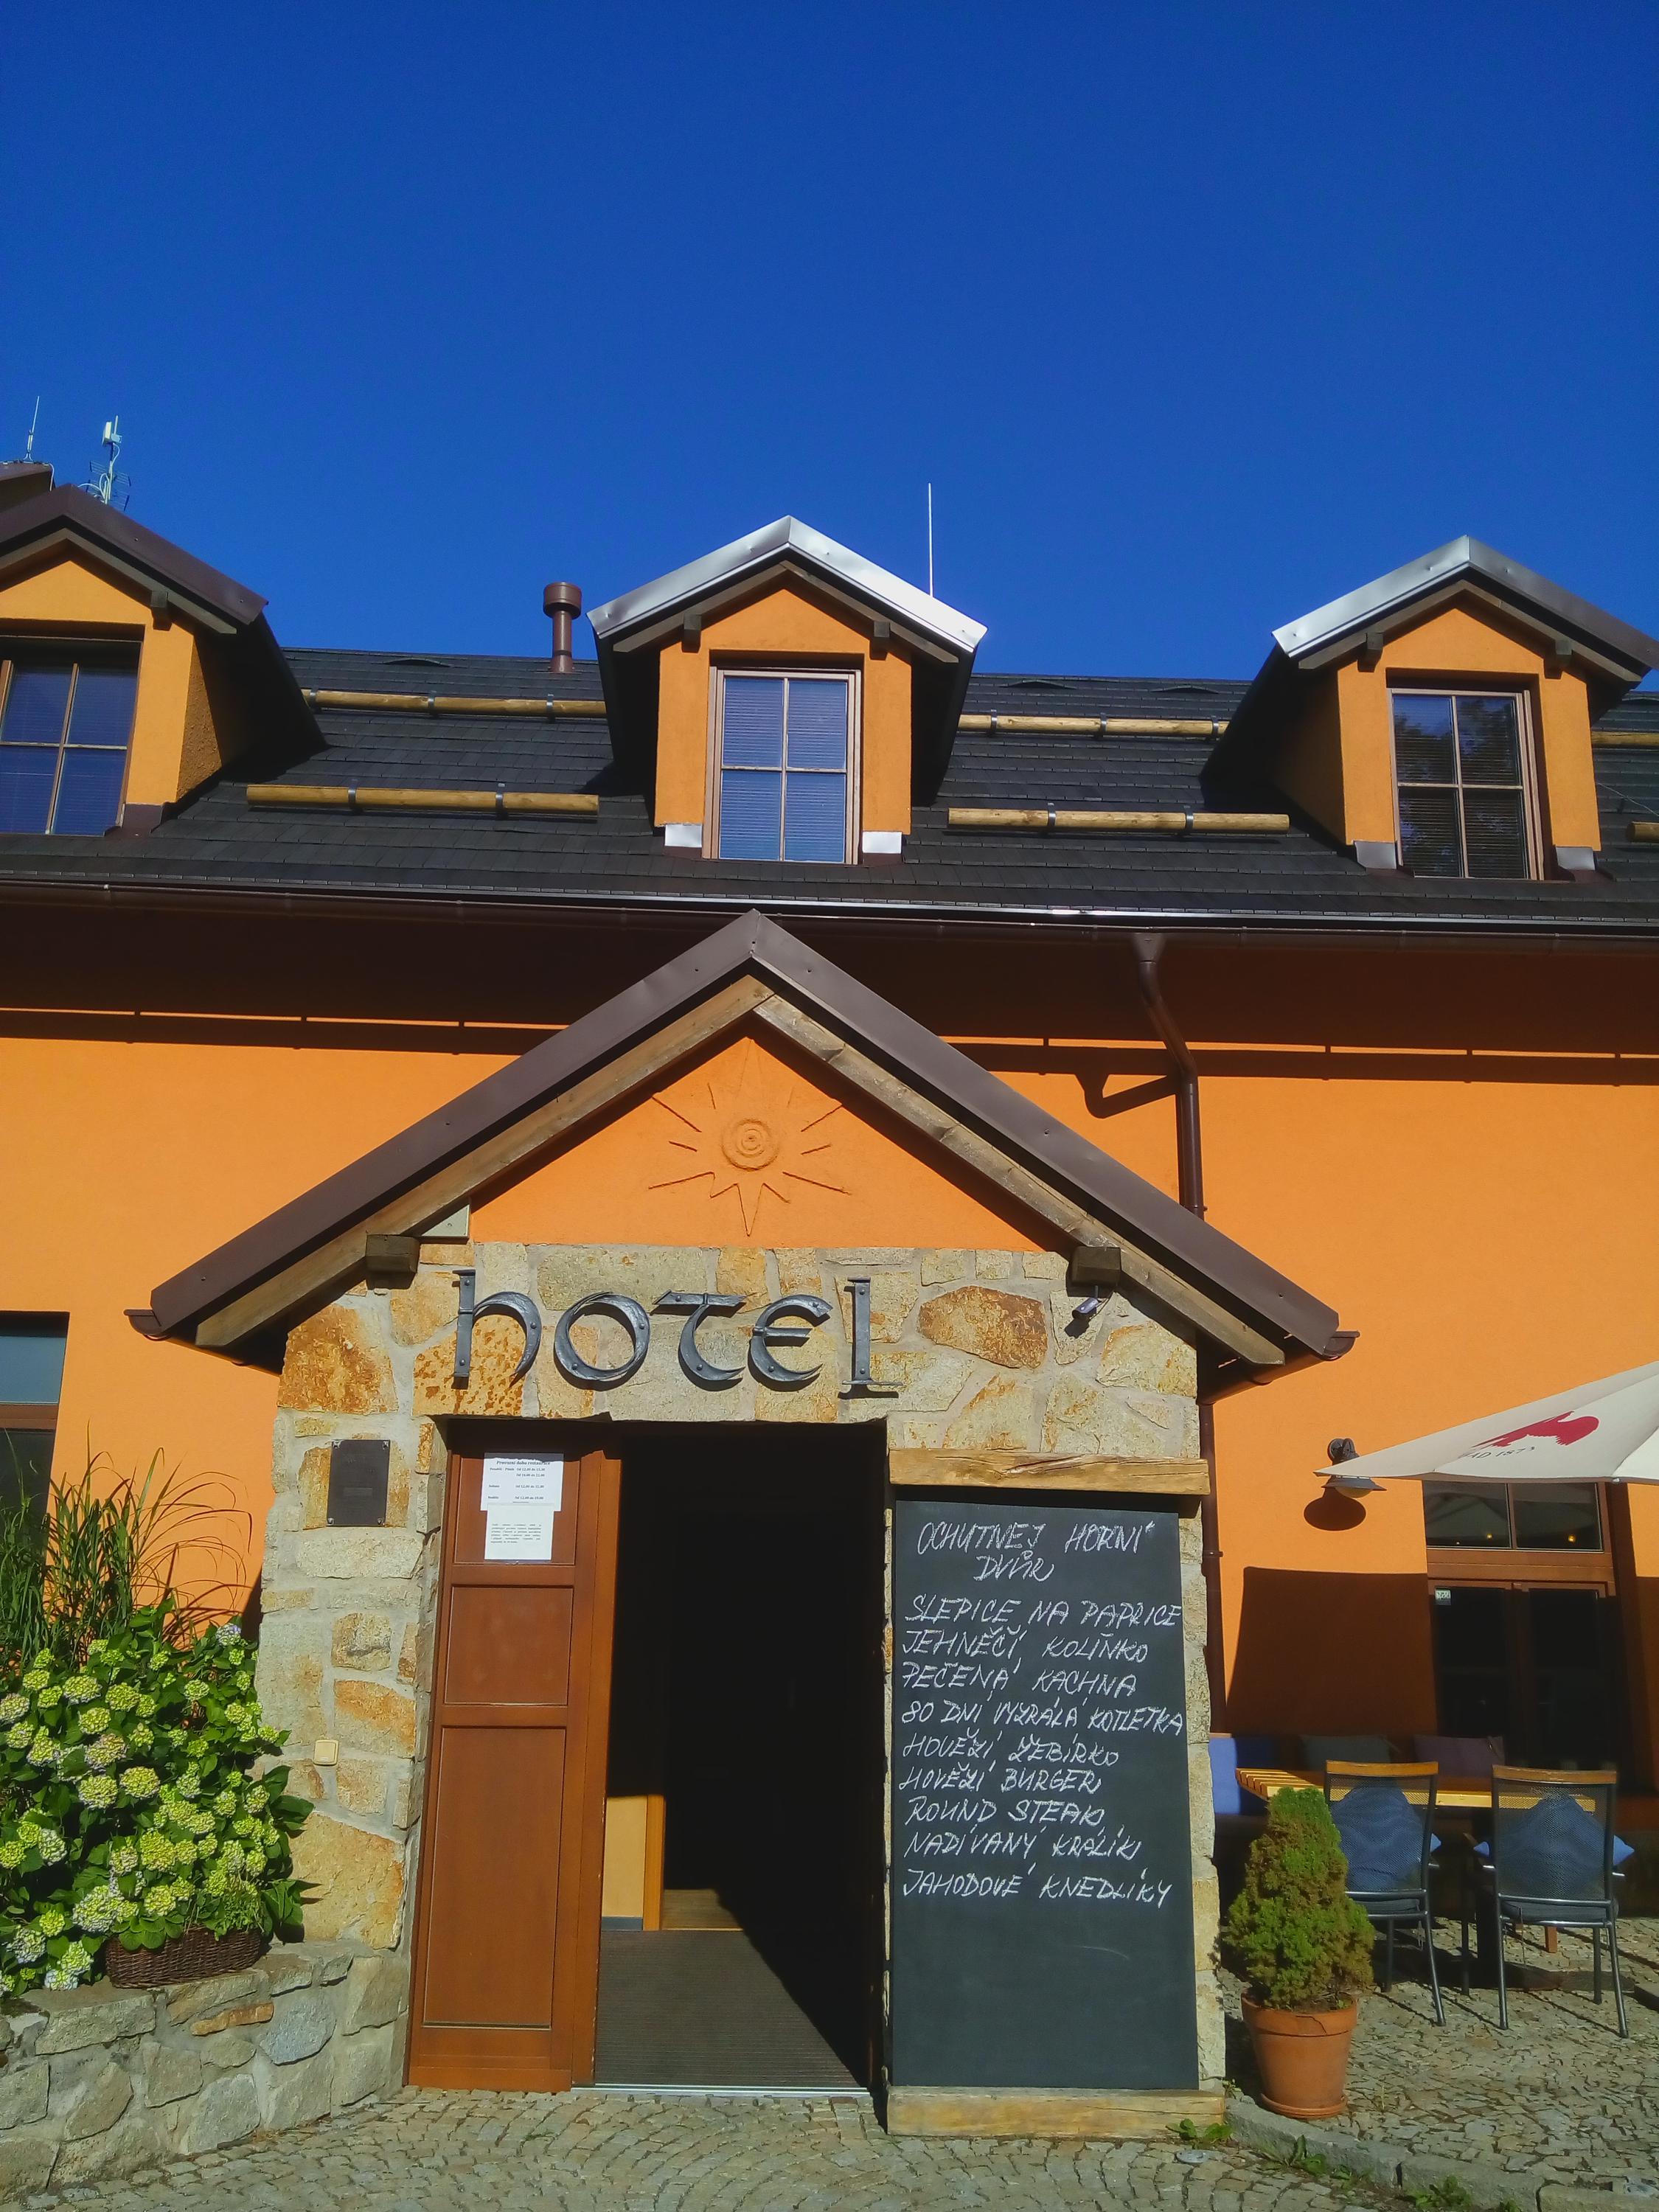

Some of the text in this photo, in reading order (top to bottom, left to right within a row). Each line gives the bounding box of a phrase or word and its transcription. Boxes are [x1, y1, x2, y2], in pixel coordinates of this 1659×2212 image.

[452, 1269, 903, 1385] hotel
[905, 1593, 1181, 1630] SLEPICE NA PAPRICE
[1032, 1669, 1136, 1698] KACHNA
[902, 1700, 933, 1723] 80
[1087, 1706, 1183, 1736] KOTLETKA
[1001, 1767, 1102, 1794] BURGER
[905, 1795, 1105, 1826] ROUND STEAK
[1039, 1867, 1172, 1908] KNEDLÍKY
